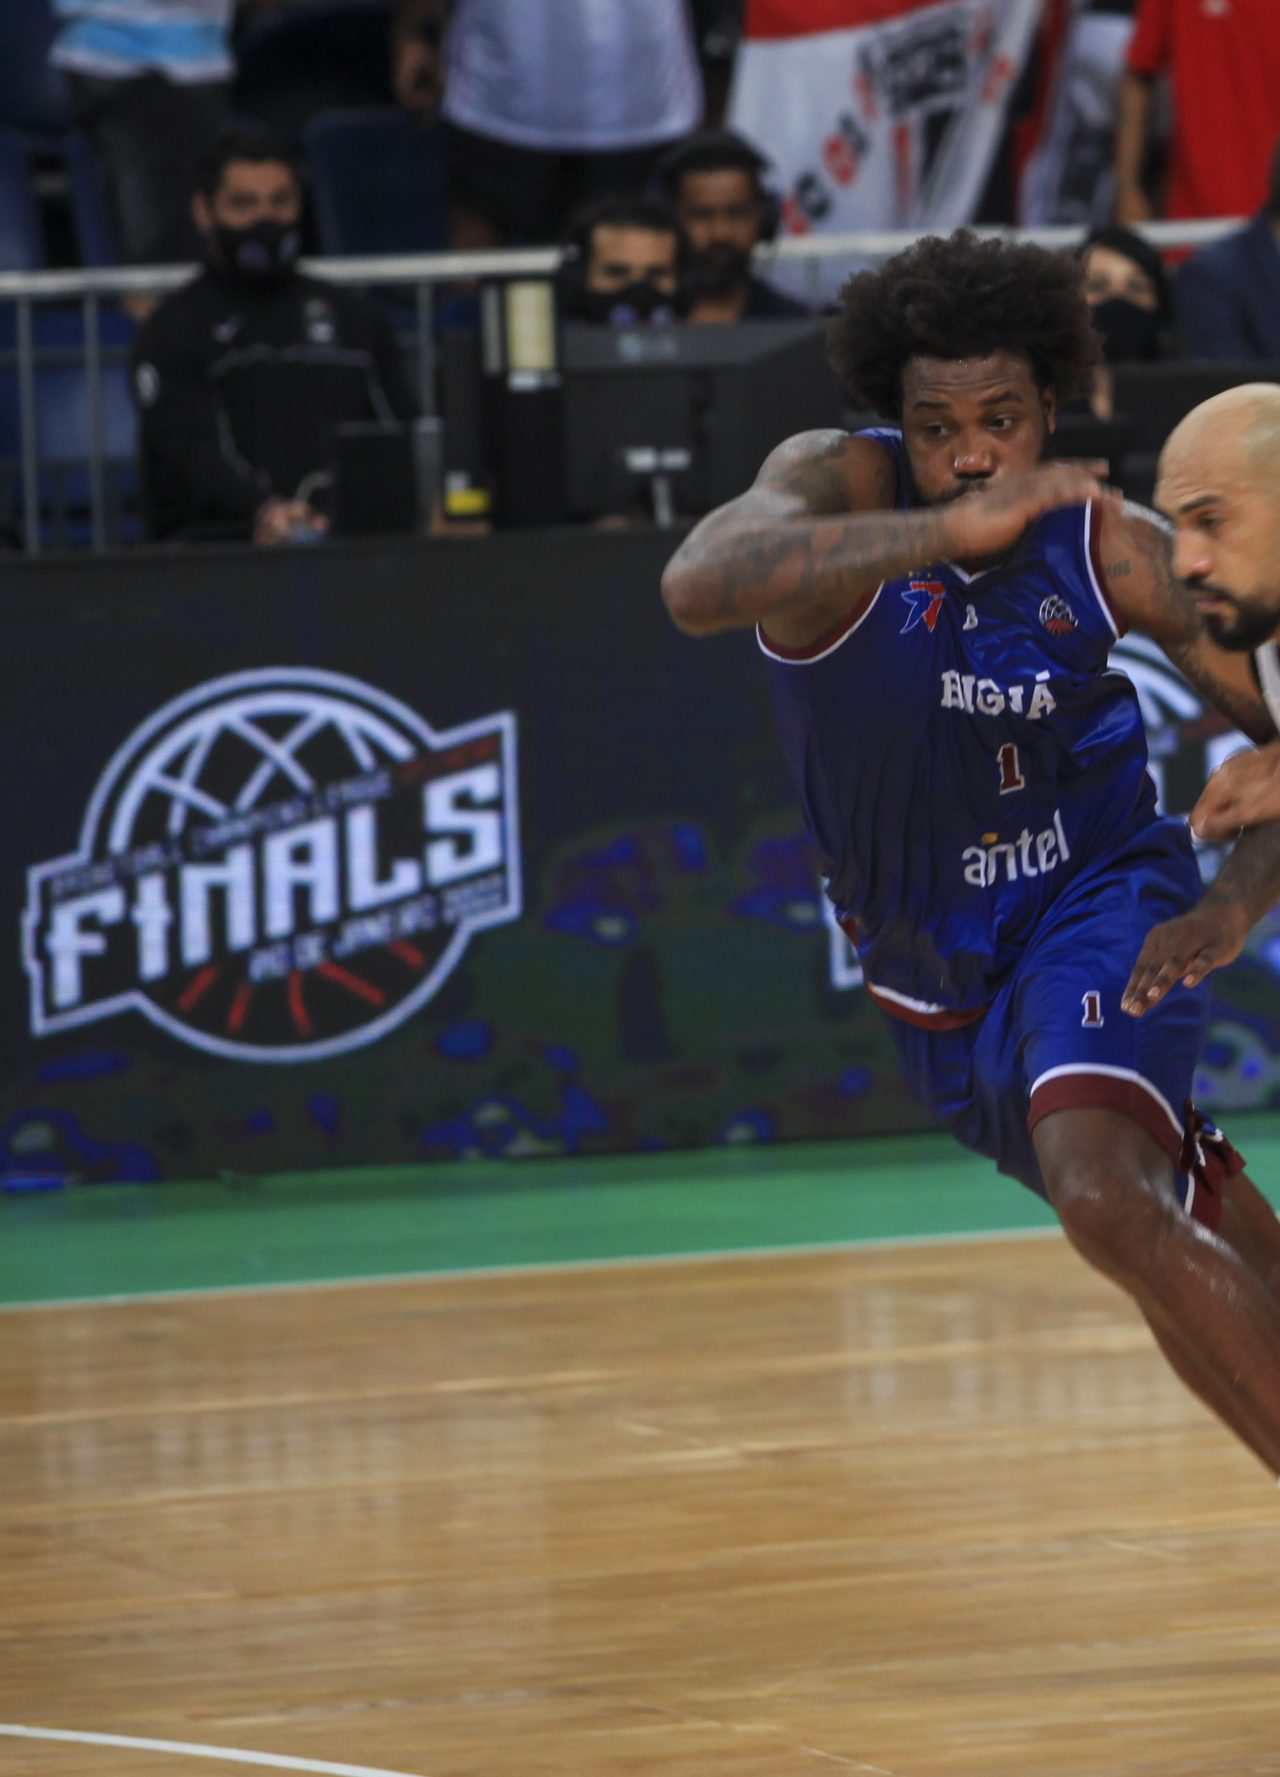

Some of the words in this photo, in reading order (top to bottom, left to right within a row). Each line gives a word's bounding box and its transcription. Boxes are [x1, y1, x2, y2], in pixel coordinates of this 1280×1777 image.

[996, 742, 1025, 796] 1
[961, 808, 1071, 888] antel
[45, 762, 502, 1008] FINALS
[1081, 990, 1104, 1028] 1
